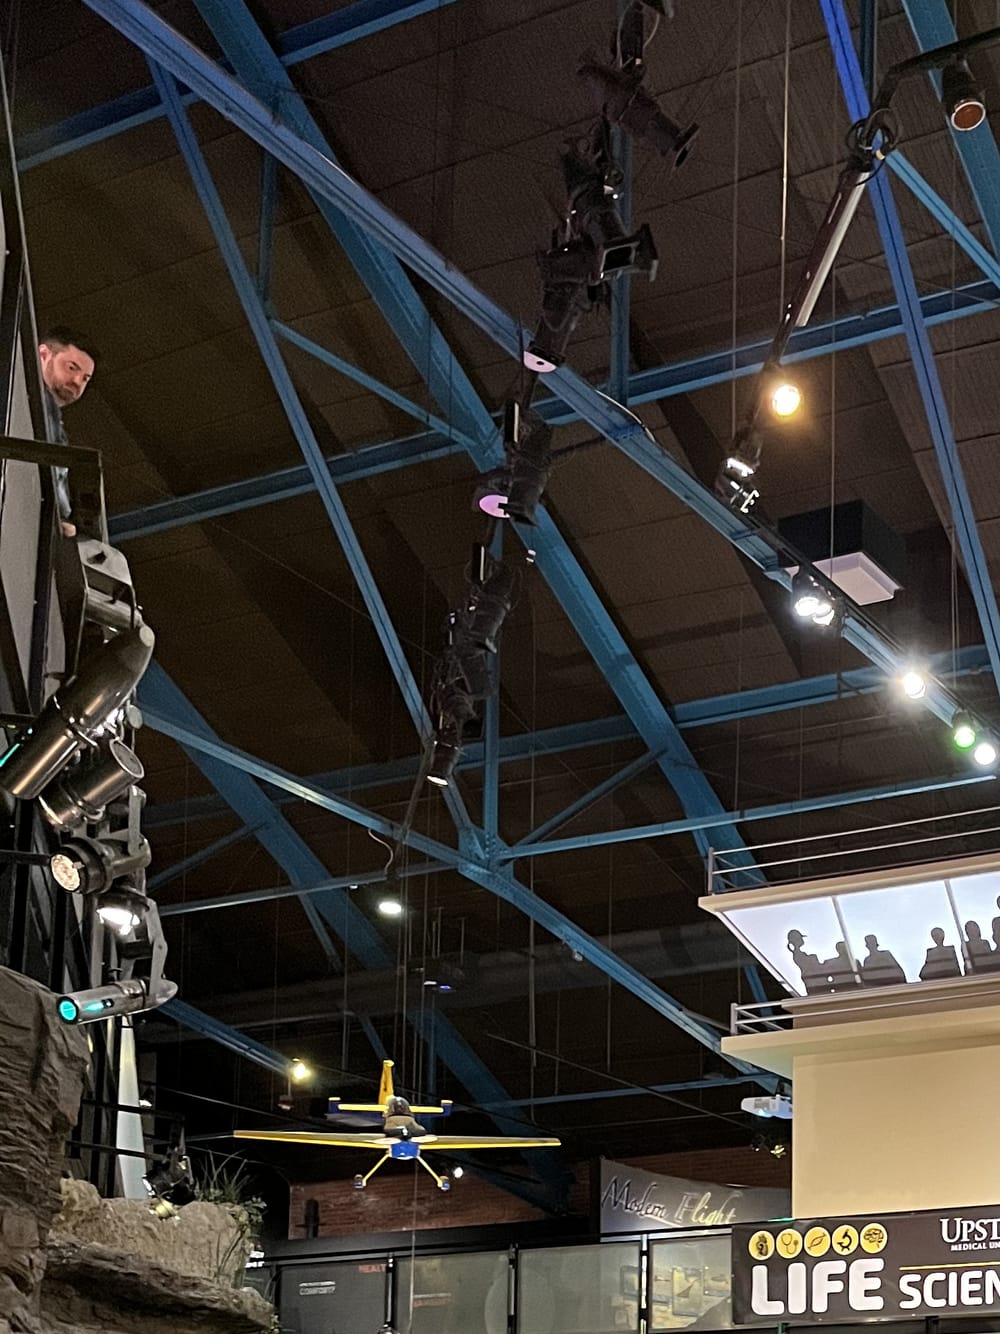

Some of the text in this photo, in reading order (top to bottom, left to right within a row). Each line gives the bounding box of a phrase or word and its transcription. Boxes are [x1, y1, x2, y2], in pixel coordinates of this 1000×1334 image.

[601, 1175, 743, 1226] Modern Flight
[950, 1242, 987, 1252] MEDICAL
[751, 1258, 885, 1316] LIFE
